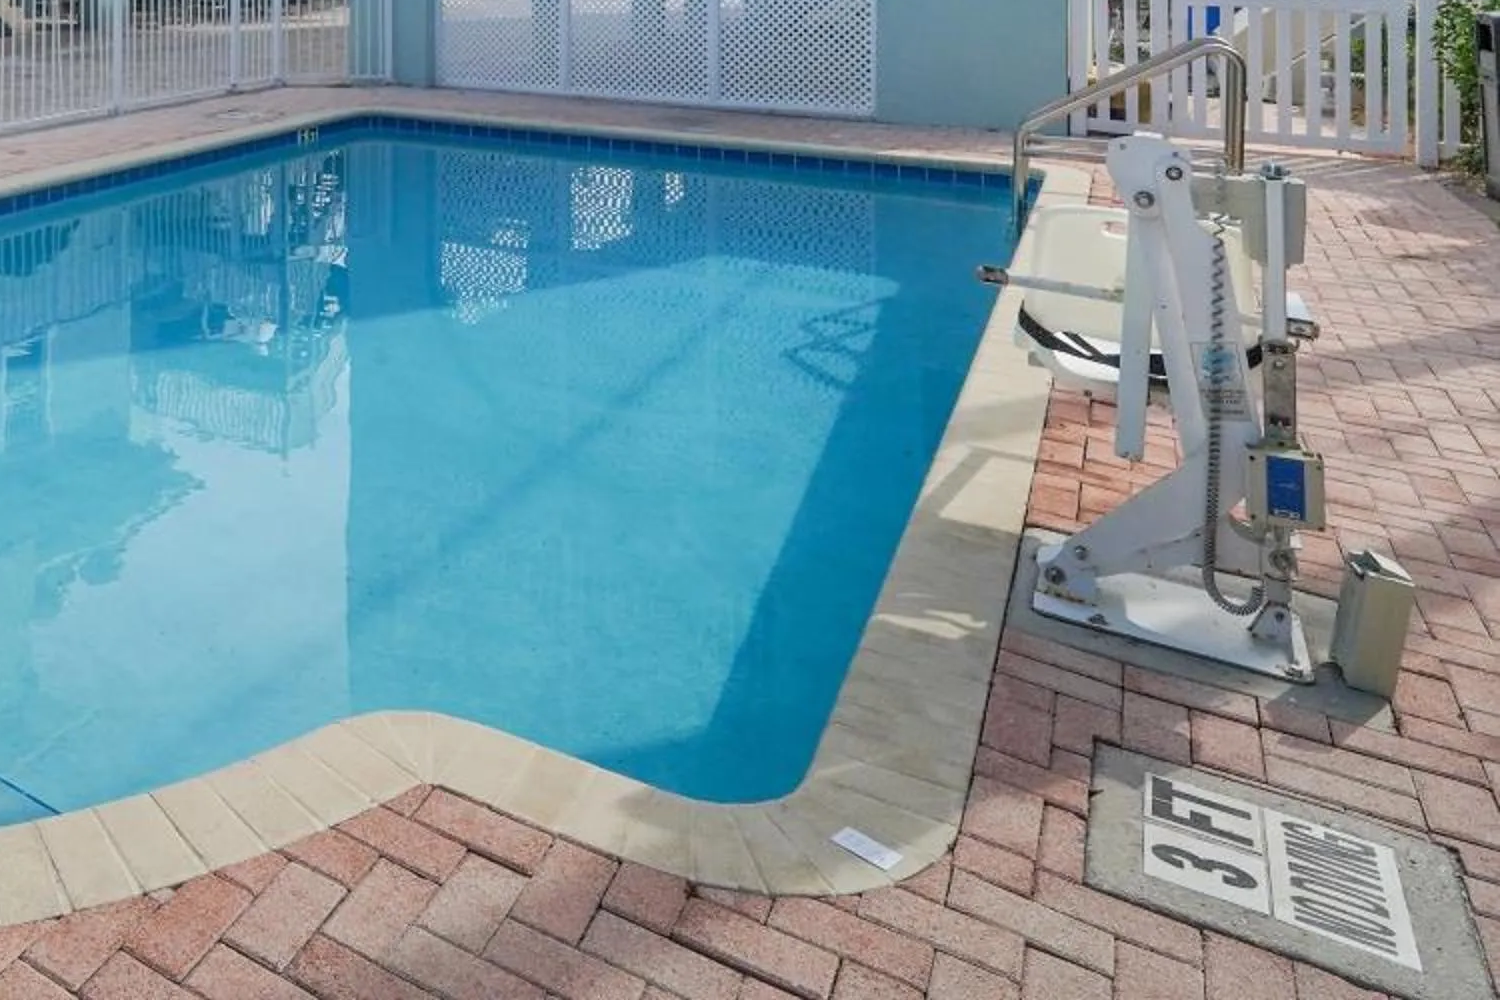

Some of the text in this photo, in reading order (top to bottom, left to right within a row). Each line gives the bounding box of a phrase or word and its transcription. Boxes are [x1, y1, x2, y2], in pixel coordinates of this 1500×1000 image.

[1151, 775, 1258, 889] 3 FT
[1281, 820, 1398, 956] NO DIVING
